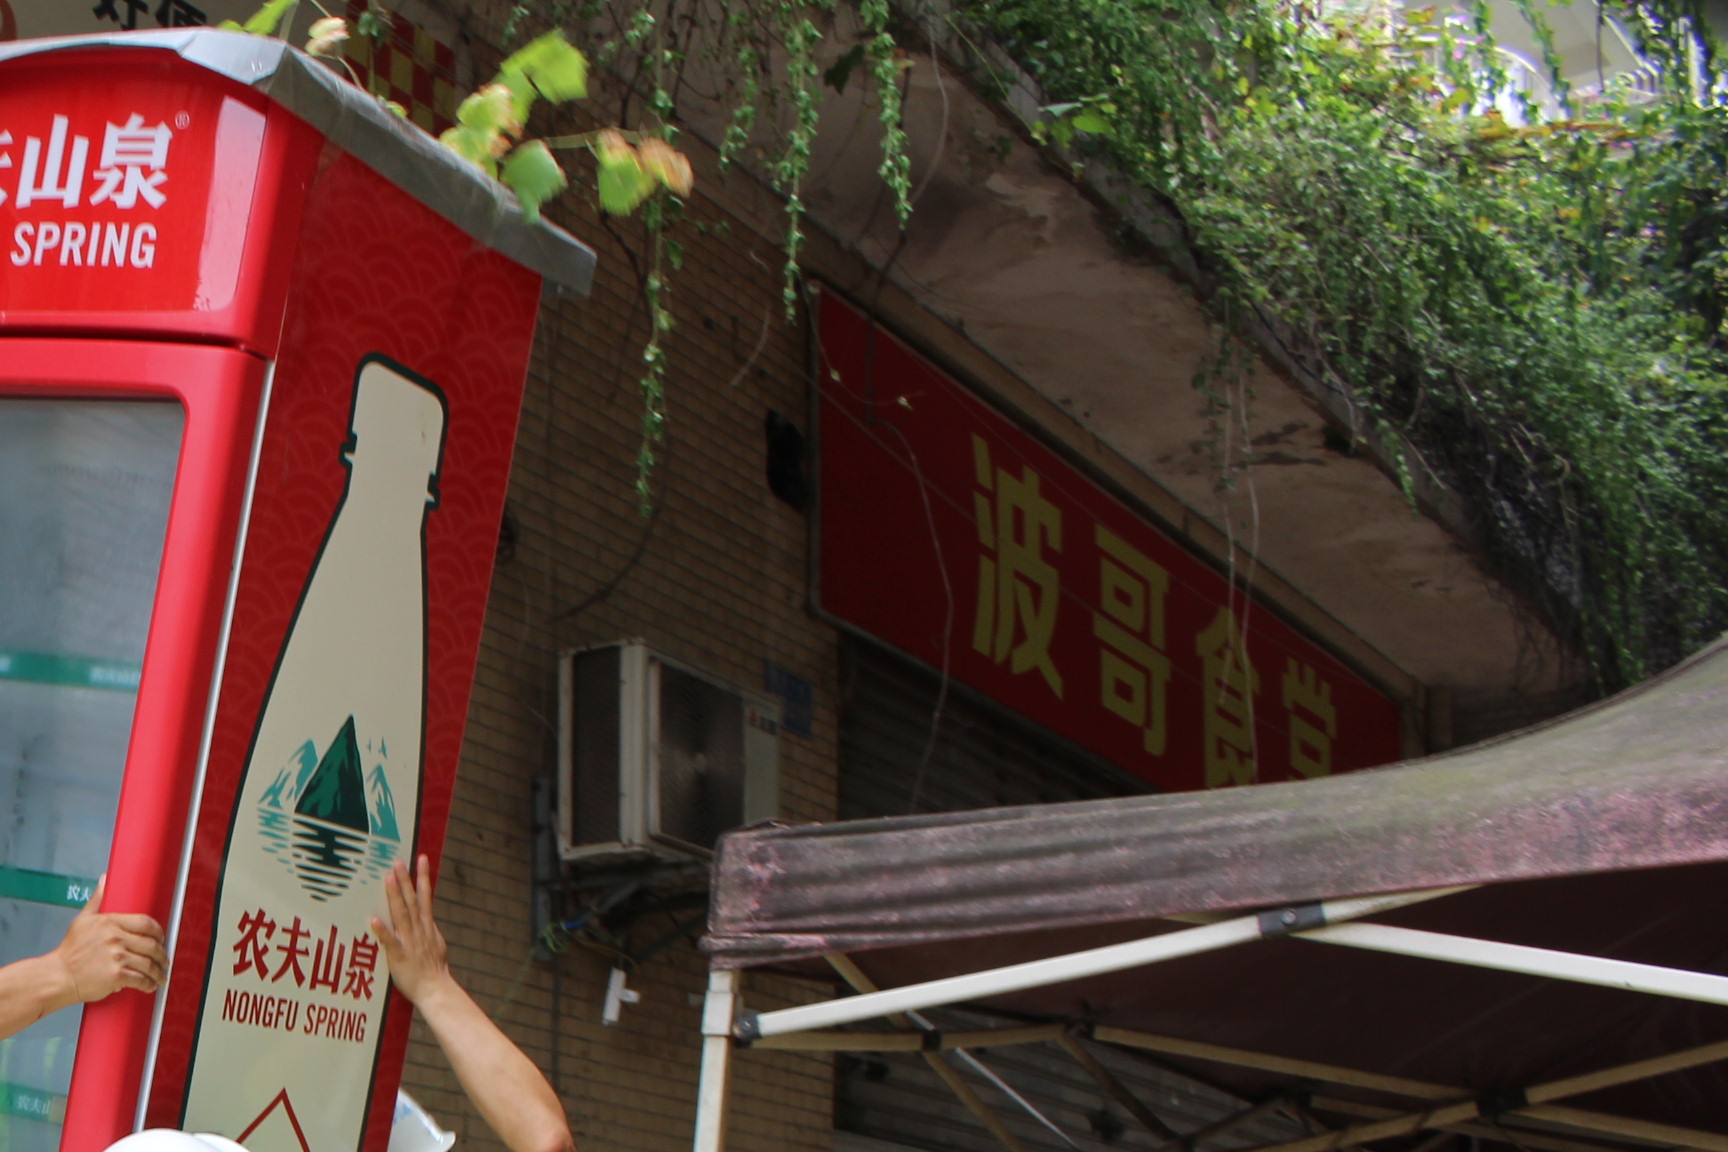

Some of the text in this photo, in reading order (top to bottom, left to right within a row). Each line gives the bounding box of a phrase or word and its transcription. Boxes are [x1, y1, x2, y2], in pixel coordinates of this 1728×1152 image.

[10, 221, 158, 269] SPRING
[972, 431, 1339, 789] 波哥食堂
[232, 907, 379, 1001] 农夫山泉
[222, 988, 367, 1043] NONGFU SPRING
